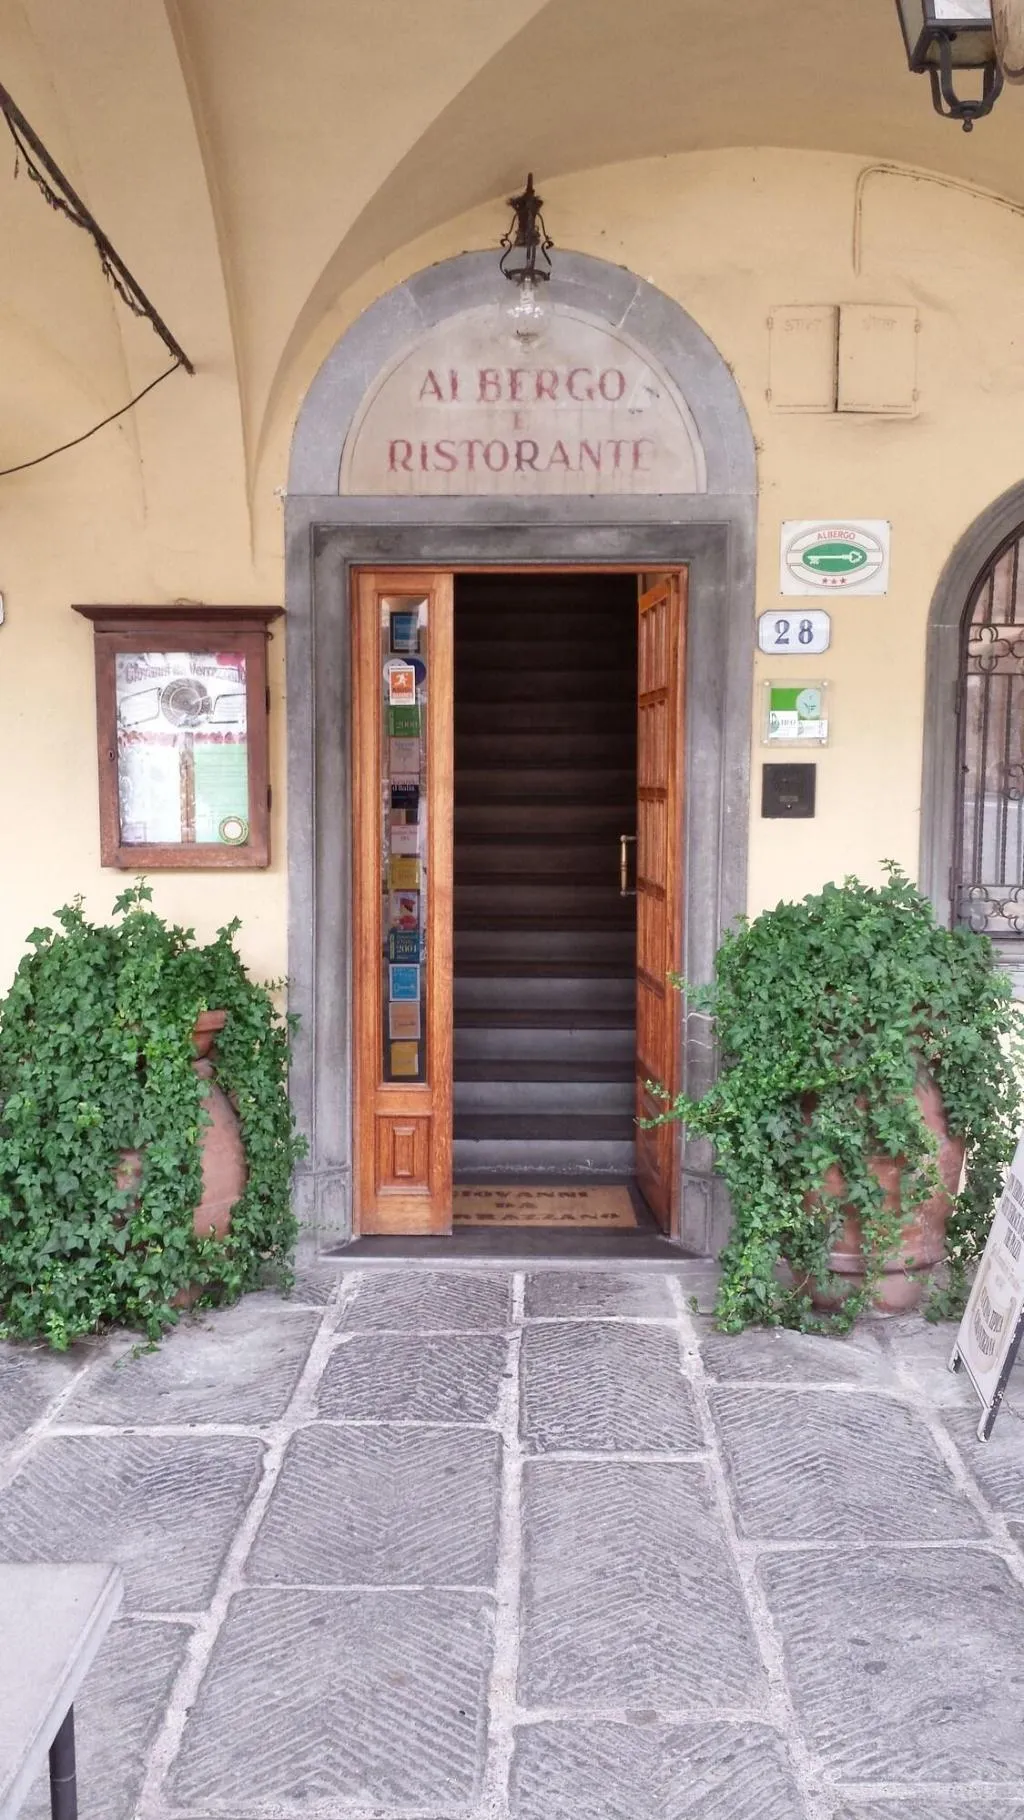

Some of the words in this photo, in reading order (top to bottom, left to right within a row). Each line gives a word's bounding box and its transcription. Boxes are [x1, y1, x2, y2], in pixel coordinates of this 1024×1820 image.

[386, 438, 656, 473] RISTORANTE
[816, 529, 857, 541] ALBERGO
[774, 619, 814, 645] 28
[396, 943, 417, 953] 2001
